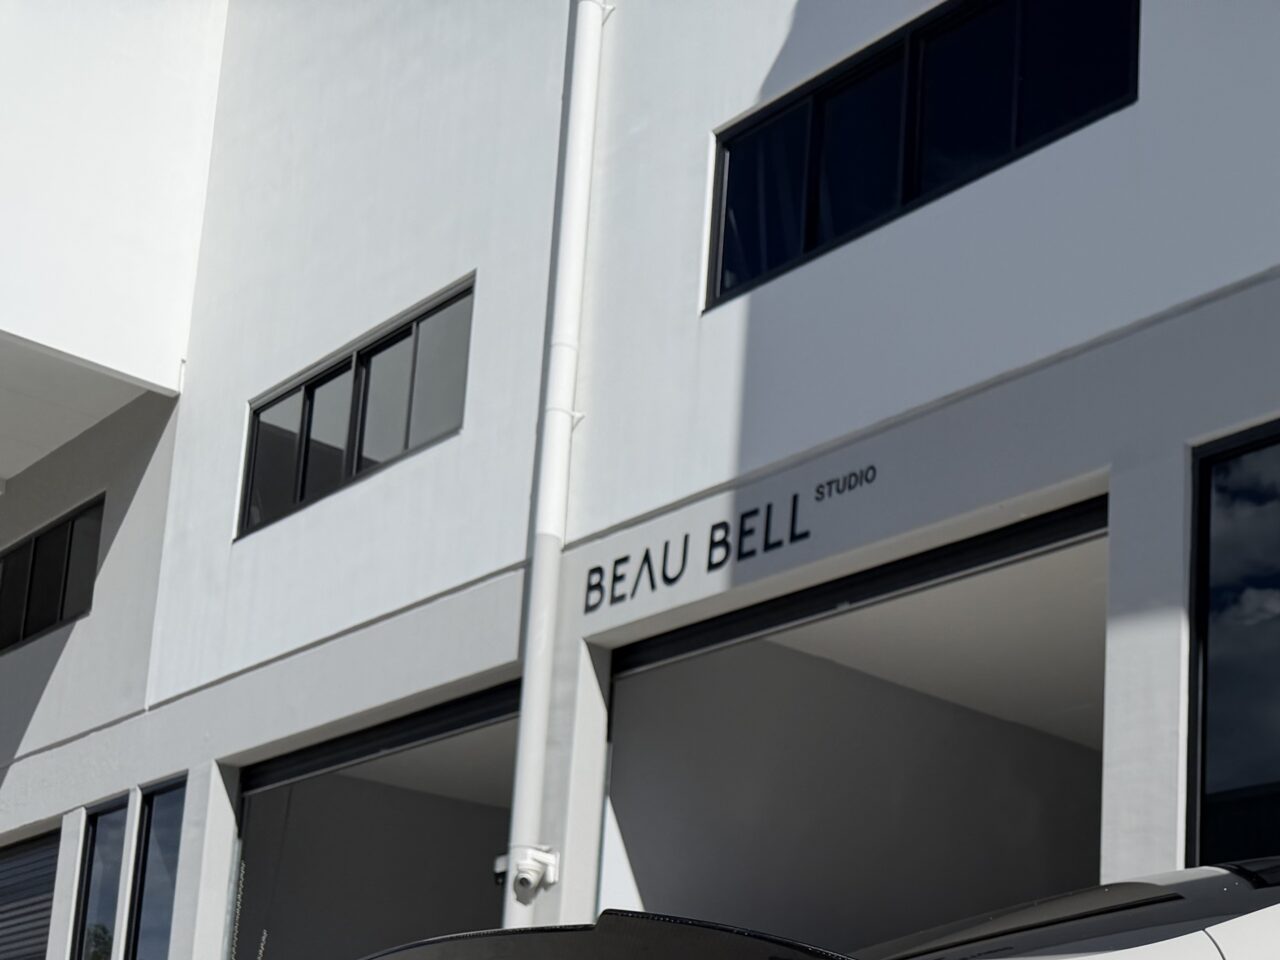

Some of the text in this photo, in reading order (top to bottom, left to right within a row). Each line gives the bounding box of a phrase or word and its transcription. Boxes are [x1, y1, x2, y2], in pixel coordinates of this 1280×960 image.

[814, 465, 877, 501] STUDIO
[583, 494, 810, 615] BEAU BELL
